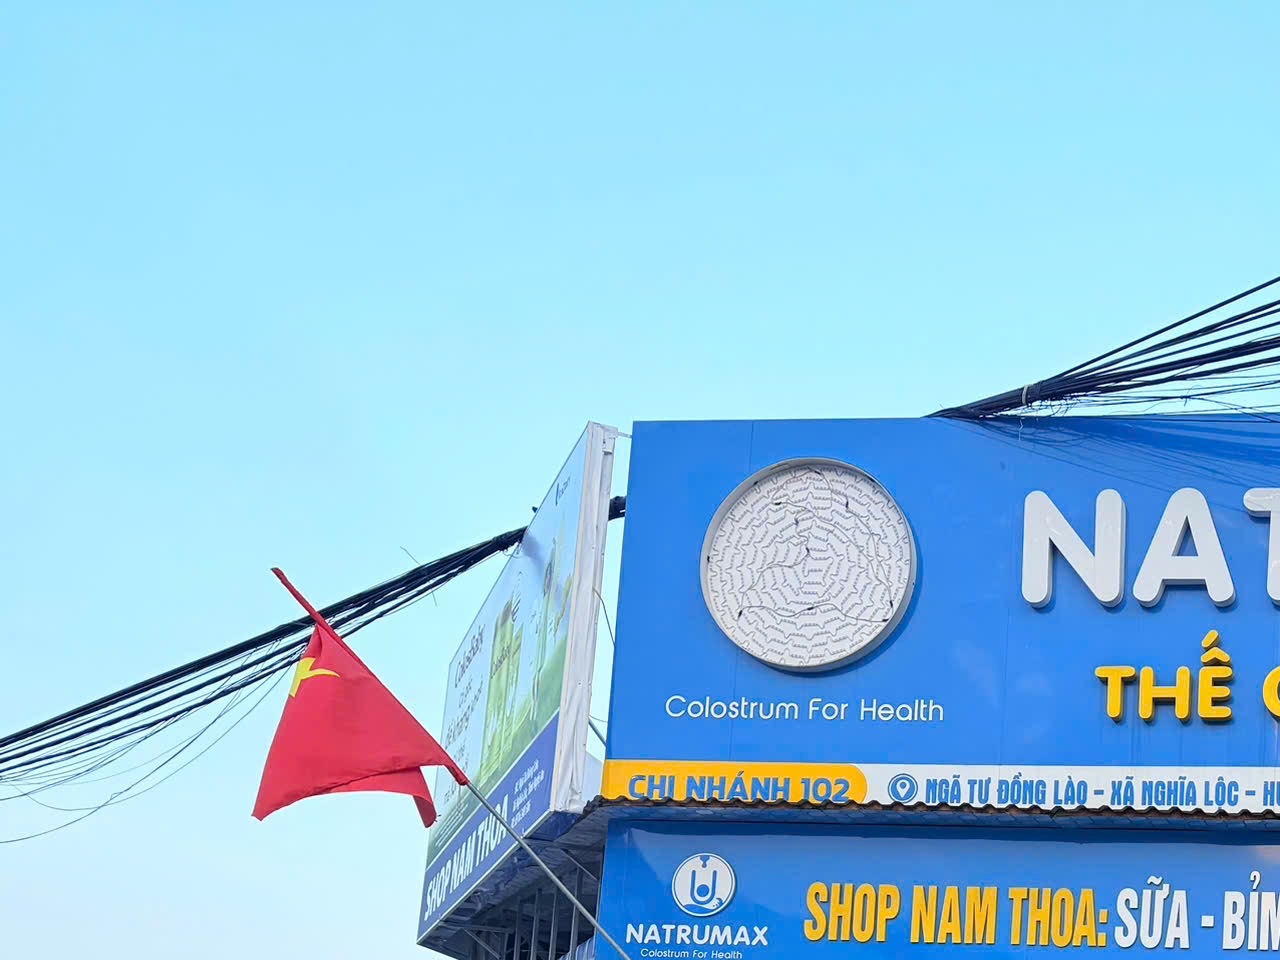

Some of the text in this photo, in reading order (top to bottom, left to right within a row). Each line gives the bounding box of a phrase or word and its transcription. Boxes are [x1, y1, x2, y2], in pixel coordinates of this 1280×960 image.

[1095, 629, 1233, 722] THẾ
[665, 694, 944, 721] Colostrum For Health
[628, 771, 849, 802] CHI NHÁNH 102
[926, 774, 960, 804] NGÃ
[968, 778, 991, 804] TƯ
[997, 772, 1046, 805] ĐỒNG
[1054, 776, 1087, 805] LÀO
[1111, 776, 1133, 806] XÃ
[1142, 776, 1196, 806] NGHĨA
[1205, 776, 1238, 810] LỘC
[424, 859, 452, 921] SHOP
[450, 829, 478, 894] NAM
[804, 882, 900, 943] SHOP
[911, 885, 998, 945] NAM
[1009, 888, 1108, 947] THOA:
[1114, 876, 1190, 949] SỮA
[626, 924, 768, 946] NATRUMAX
[641, 949, 742, 959] Colostrum For Health
